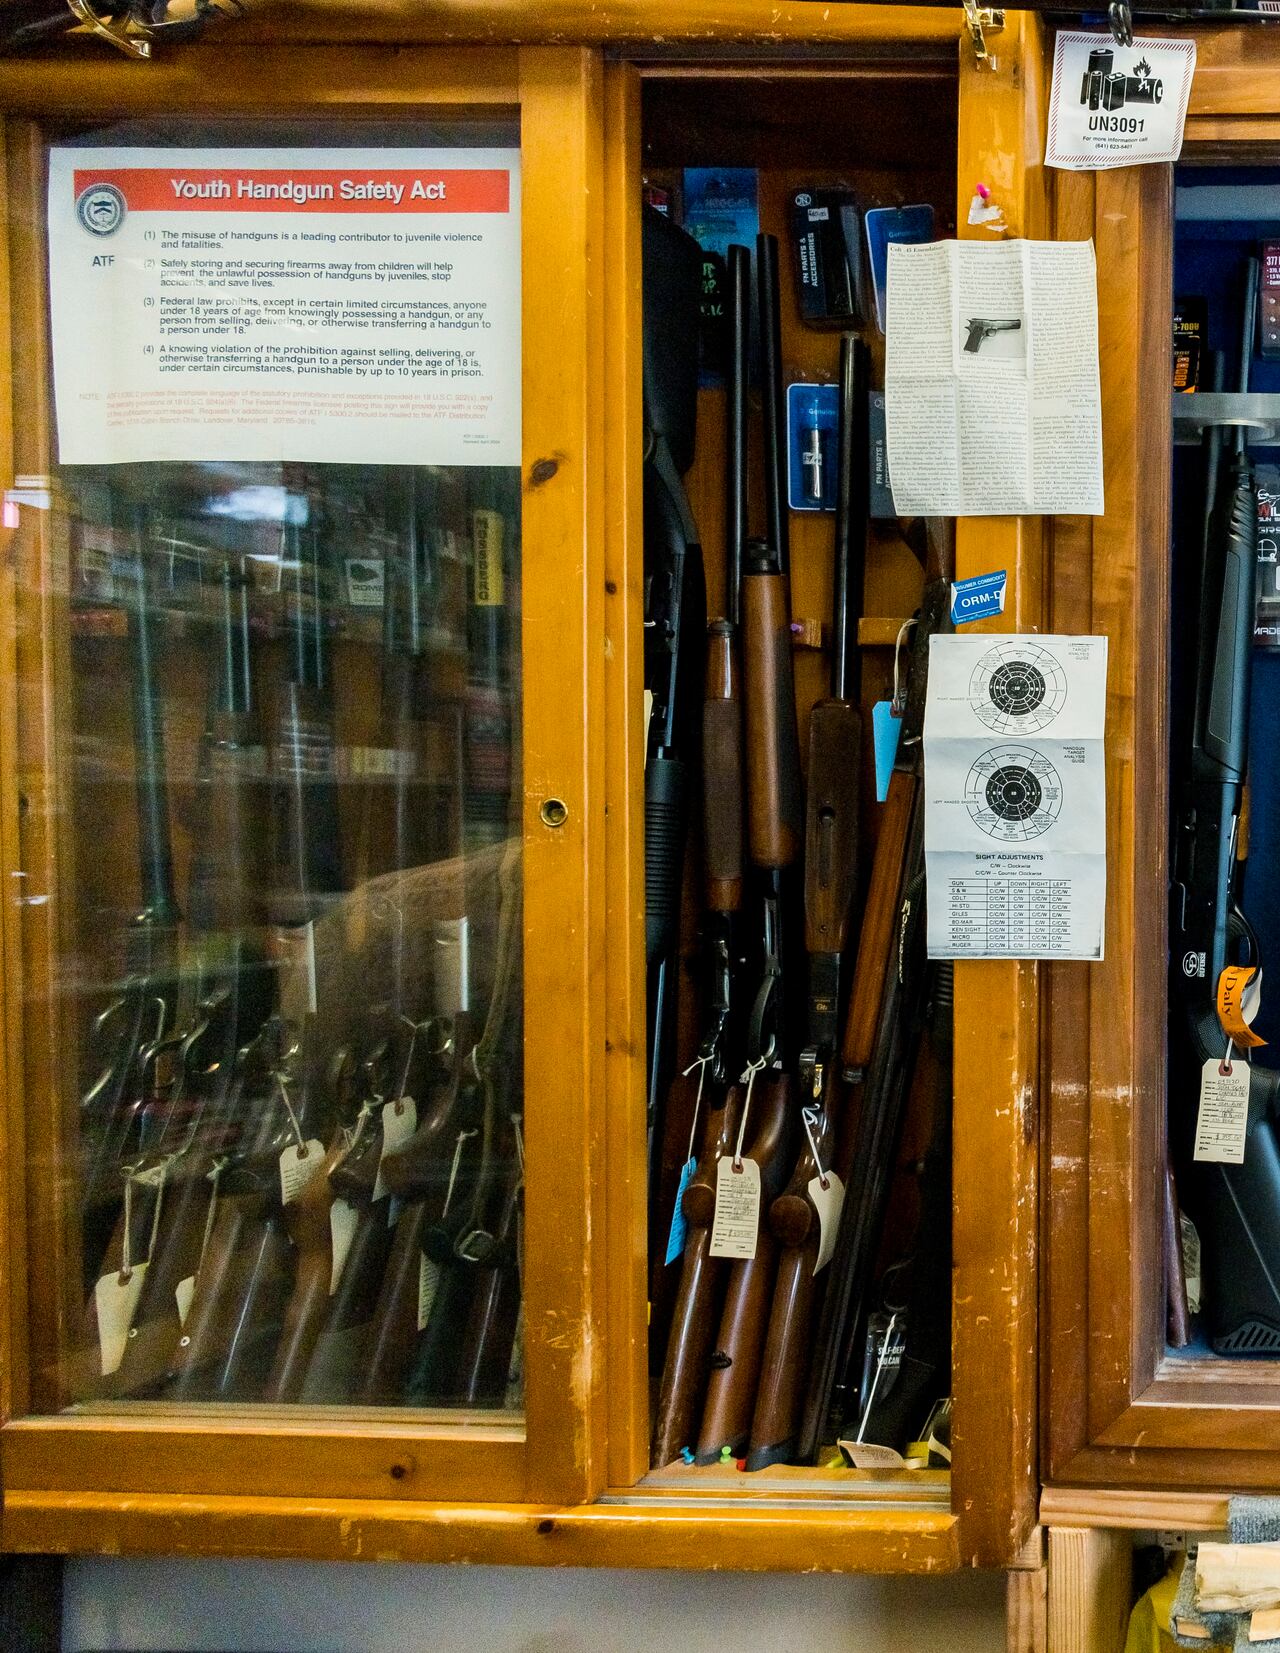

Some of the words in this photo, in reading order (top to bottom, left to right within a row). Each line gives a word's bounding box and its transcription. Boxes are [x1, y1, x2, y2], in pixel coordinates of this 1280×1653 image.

[1088, 116, 1145, 133] UN3091
[170, 179, 231, 200] Youth
[237, 179, 334, 204] Handgun
[339, 179, 405, 205] Safety
[410, 179, 447, 200] Act
[144, 231, 156, 241] (1)
[161, 231, 179, 239] The
[181, 231, 216, 240] misuse
[230, 231, 279, 242] handguns
[300, 232, 336, 242] leading
[338, 232, 390, 241] contributor
[405, 233, 441, 243] juvenile
[443, 233, 483, 241] violence
[160, 240, 179, 249] and
[181, 240, 224, 249] fatalities.
[92, 256, 115, 267] ATF
[808, 232, 818, 287] ACCESSORIES
[1266, 256, 1278, 266] 377
[161, 259, 188, 270] Safely
[190, 260, 223, 270] storing
[225, 260, 243, 269] and
[245, 260, 285, 270] securing
[287, 261, 326, 270] firearms
[328, 263, 352, 272] away
[354, 262, 376, 271] from
[378, 262, 415, 271] children
[416, 262, 432, 271] will
[433, 262, 453, 273] help
[199, 269, 214, 277] the
[216, 269, 255, 278] unlawful
[257, 270, 311, 280] possession
[325, 271, 372, 281] handguns
[388, 272, 429, 282] juveniles,
[431, 272, 451, 282] stop
[803, 273, 809, 284] FN
[208, 279, 226, 287] and
[251, 279, 274, 287] lives.
[876, 474, 883, 485] FN
[977, 573, 1006, 585] COMMODITY
[961, 590, 1001, 608] ORM-D
[1222, 977, 1237, 1017] Daly
